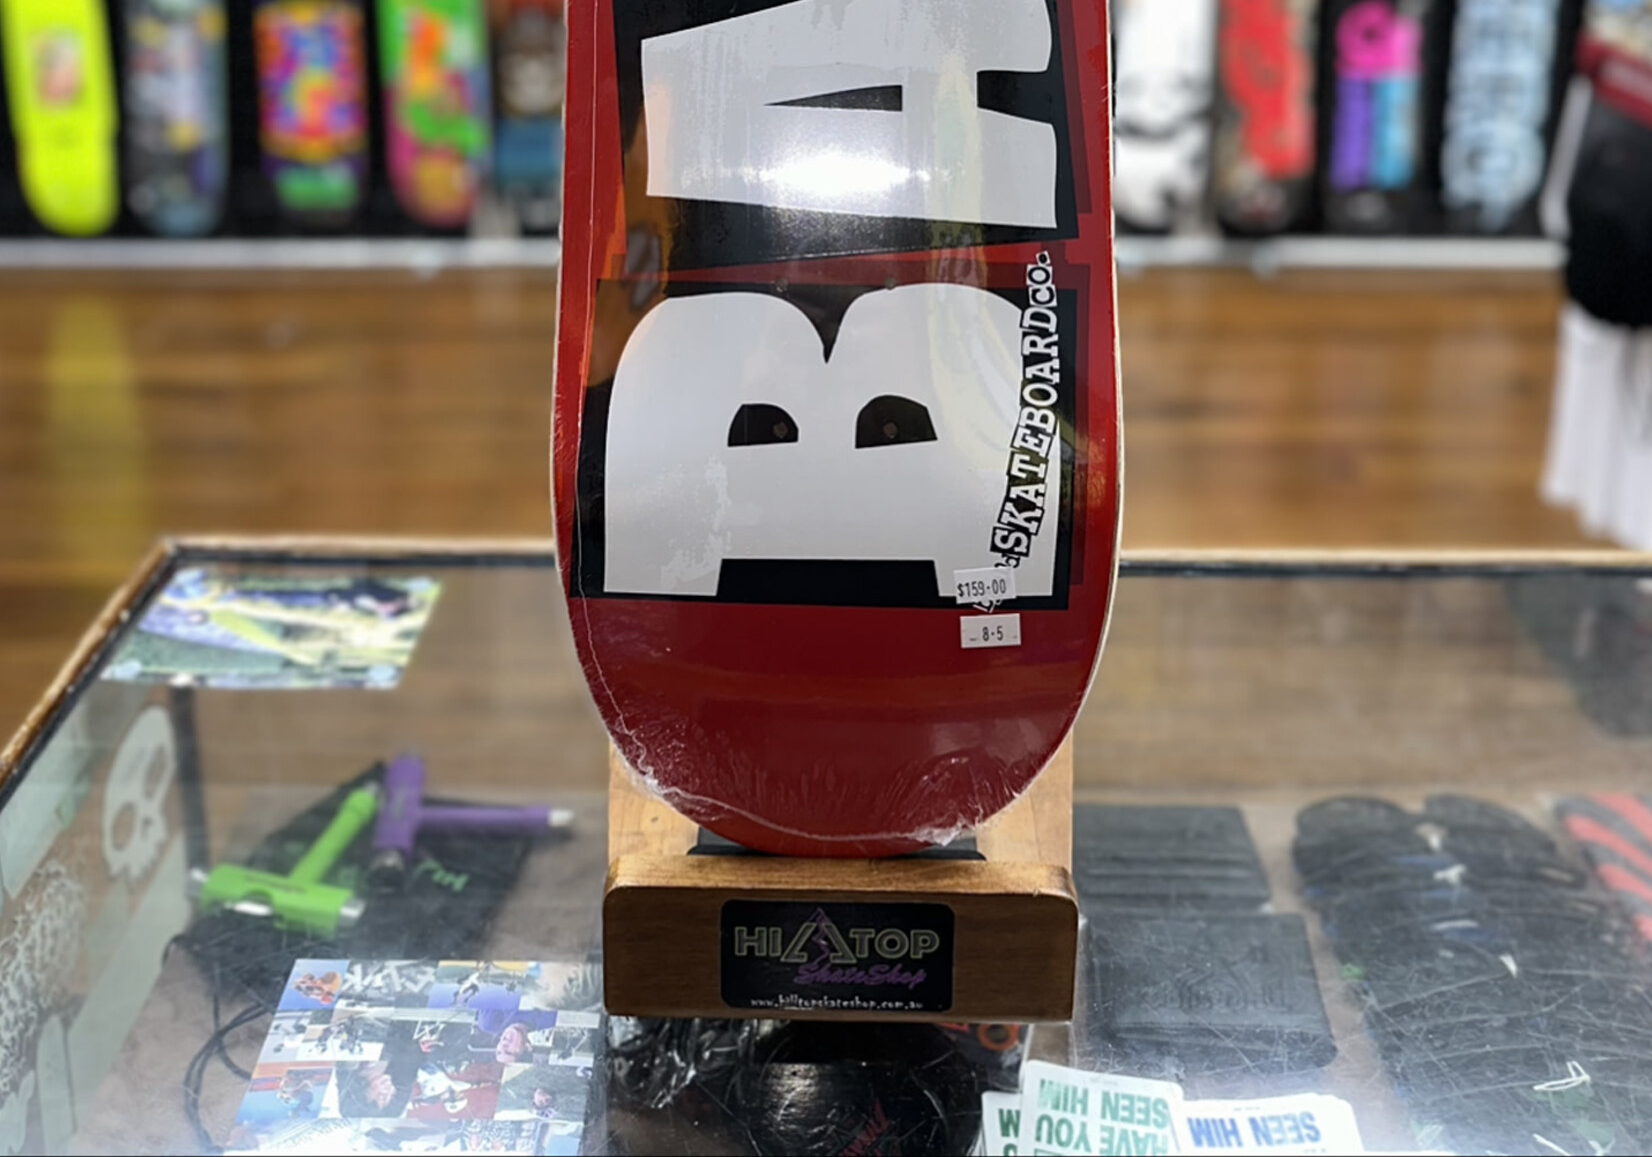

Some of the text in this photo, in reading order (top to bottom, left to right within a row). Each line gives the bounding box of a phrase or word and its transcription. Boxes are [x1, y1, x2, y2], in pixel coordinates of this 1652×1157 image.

[1038, 1078, 1169, 1129] SEEN HIM
[1034, 1113, 1092, 1154] YOU
[1187, 1112, 1322, 1150] SEEN HIM
